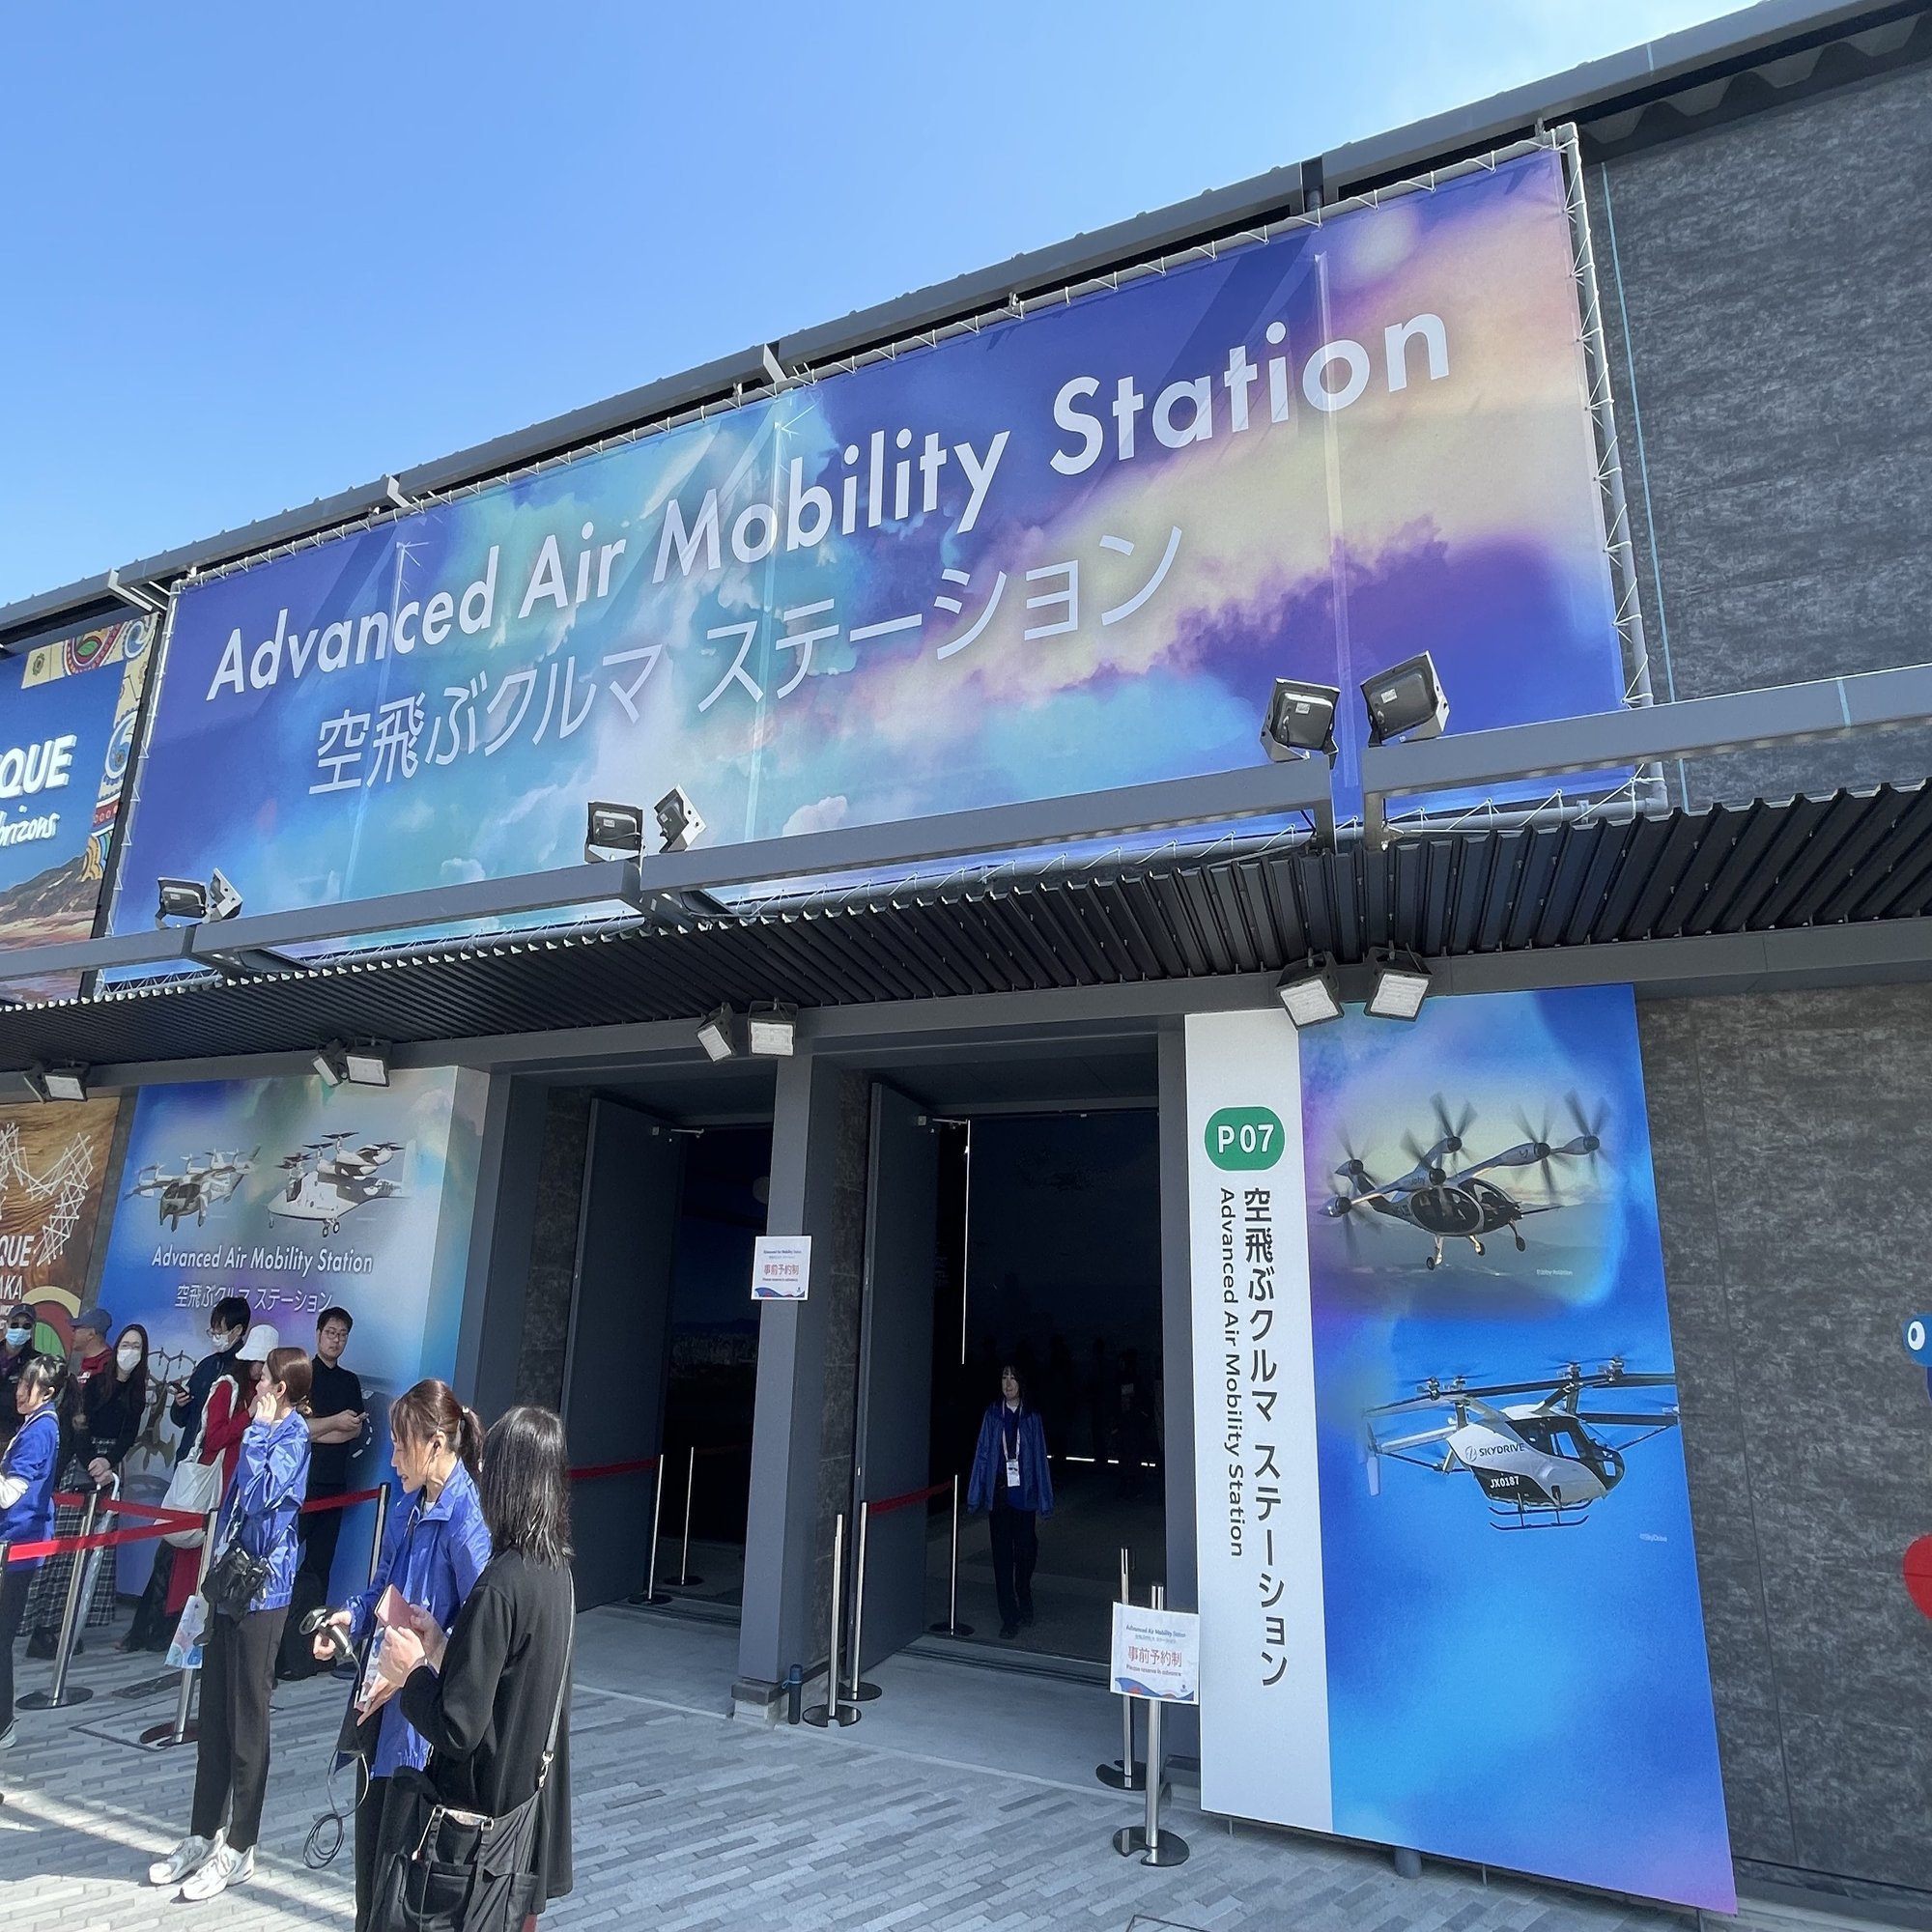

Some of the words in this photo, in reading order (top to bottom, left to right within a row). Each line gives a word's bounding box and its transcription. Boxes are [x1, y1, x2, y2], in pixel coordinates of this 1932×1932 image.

[206, 546, 499, 700] Advanced
[517, 522, 626, 618] Air
[652, 428, 1011, 583] Mobility
[1050, 312, 1450, 475] Station
[308, 645, 665, 795] 空飛ぶクルマ
[697, 526, 1182, 713] ステーション
[1216, 1122, 1275, 1153] P07
[151, 1244, 223, 1268] Advanced
[224, 1246, 247, 1269] Air
[249, 1245, 314, 1278] Mobility
[317, 1247, 373, 1274] Station
[1219, 1187, 1239, 1304] Advanced
[254, 1287, 332, 1314] ステーション
[1224, 1310, 1239, 1347] Air
[1244, 1187, 1278, 1423] 空飛ぶクルマ
[1224, 1353, 1243, 1458] Mobility
[1478, 1442, 1525, 1457] SKYDRIVE
[1490, 1475, 1520, 1489] JX0187
[1229, 1463, 1245, 1557] Station
[1254, 1444, 1289, 1688] ステーション
[1127, 1645, 1182, 1668] 事前予約制
